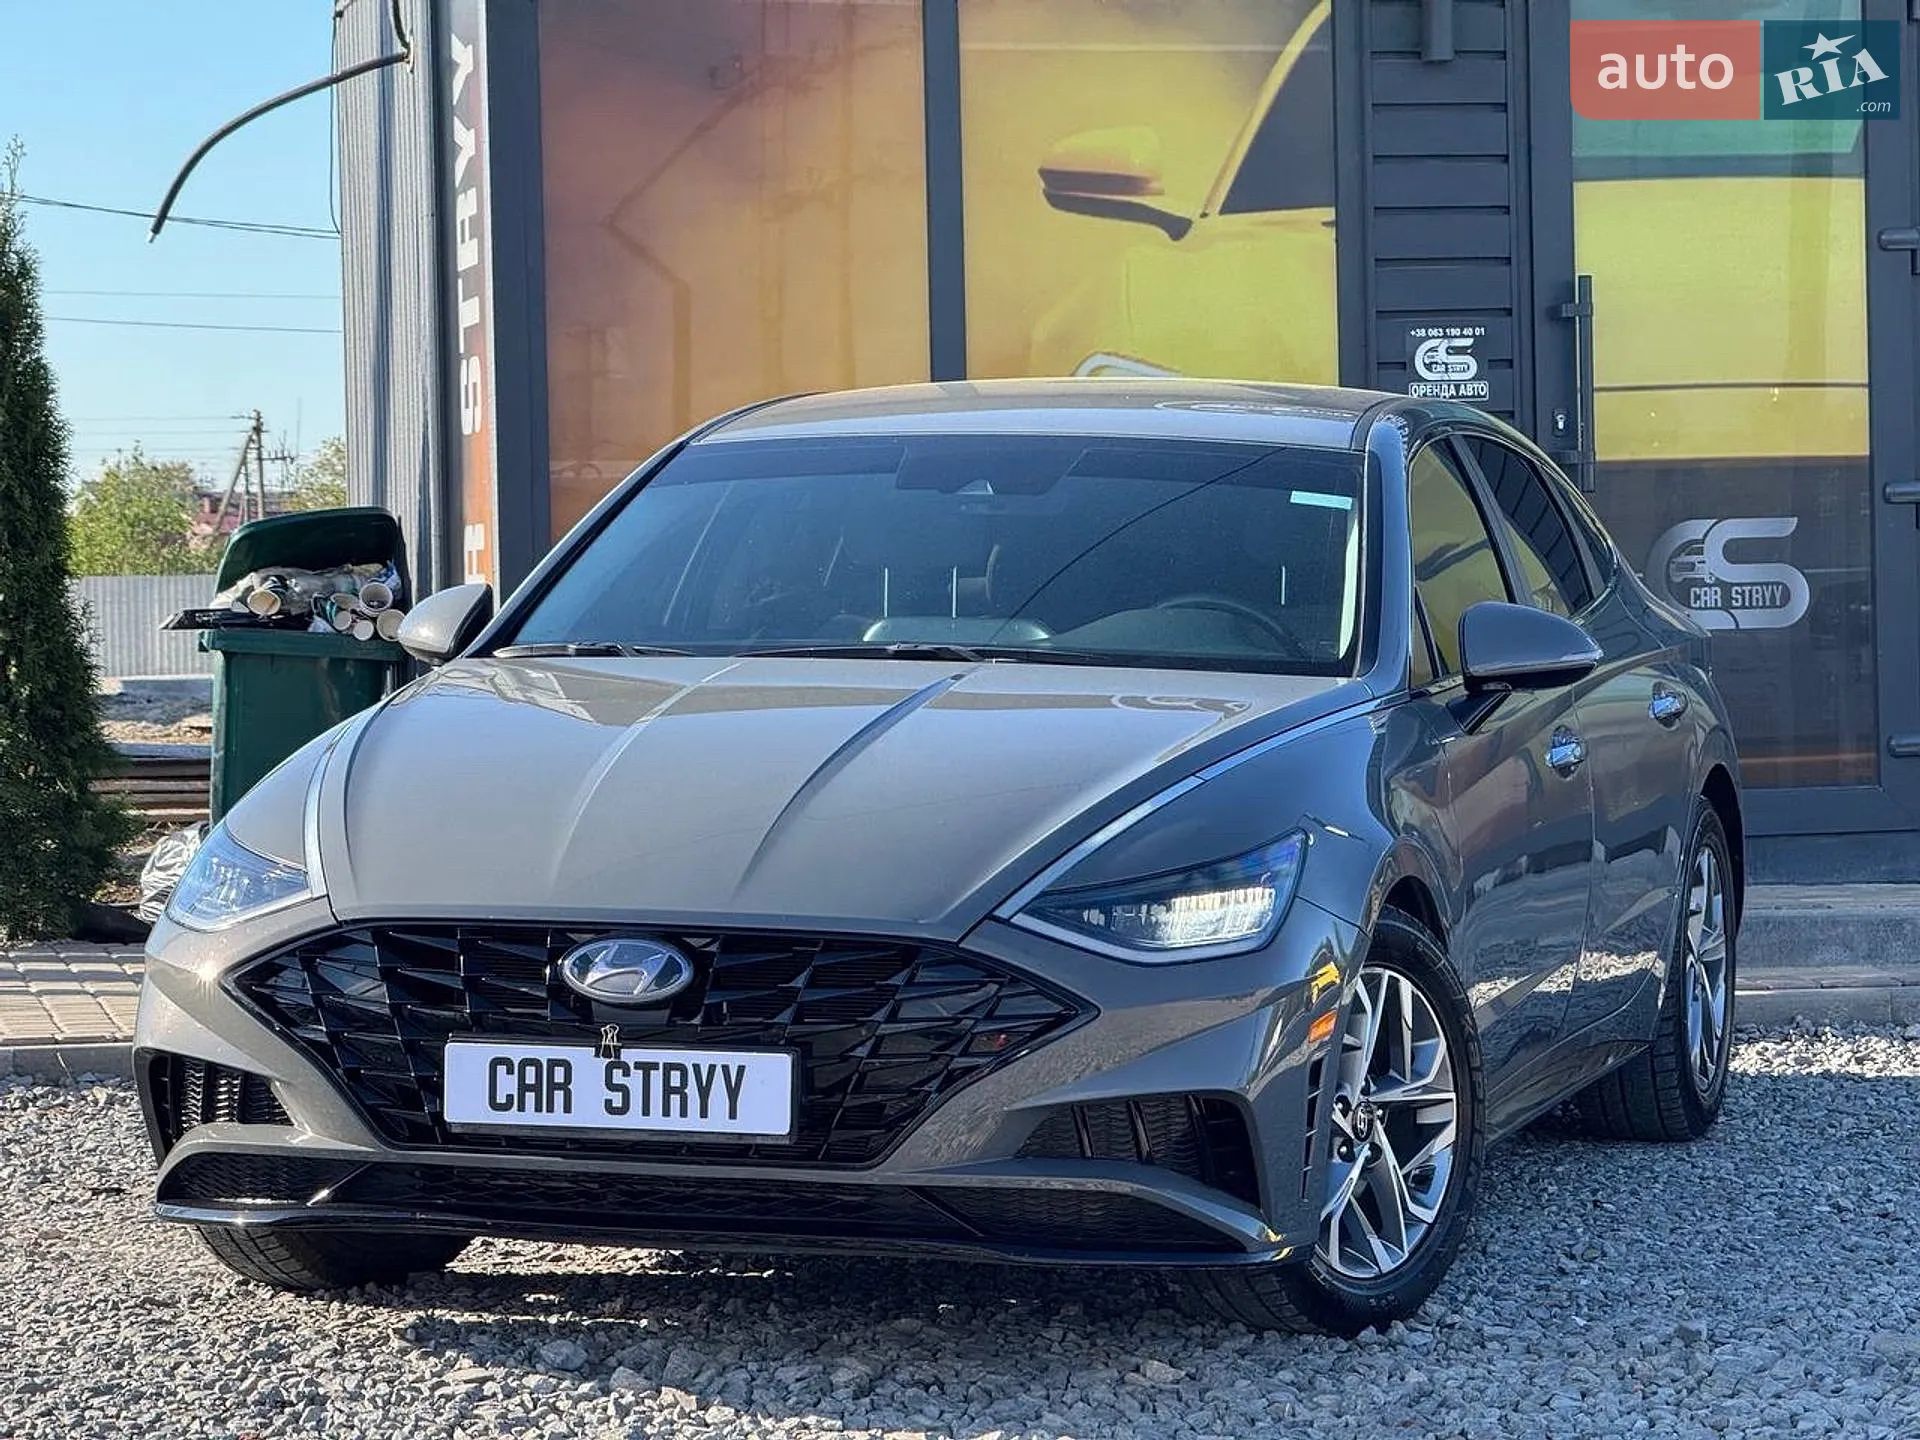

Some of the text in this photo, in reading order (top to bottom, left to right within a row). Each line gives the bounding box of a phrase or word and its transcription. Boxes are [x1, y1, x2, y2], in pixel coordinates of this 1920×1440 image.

[451, 33, 482, 435] STRYY
[1474, 327, 1485, 336] 01
[1411, 383, 1487, 399] ОРЕНДА АВТО
[1690, 584, 1783, 608] CAR STRYY
[488, 1056, 746, 1119] CAR STRYY
